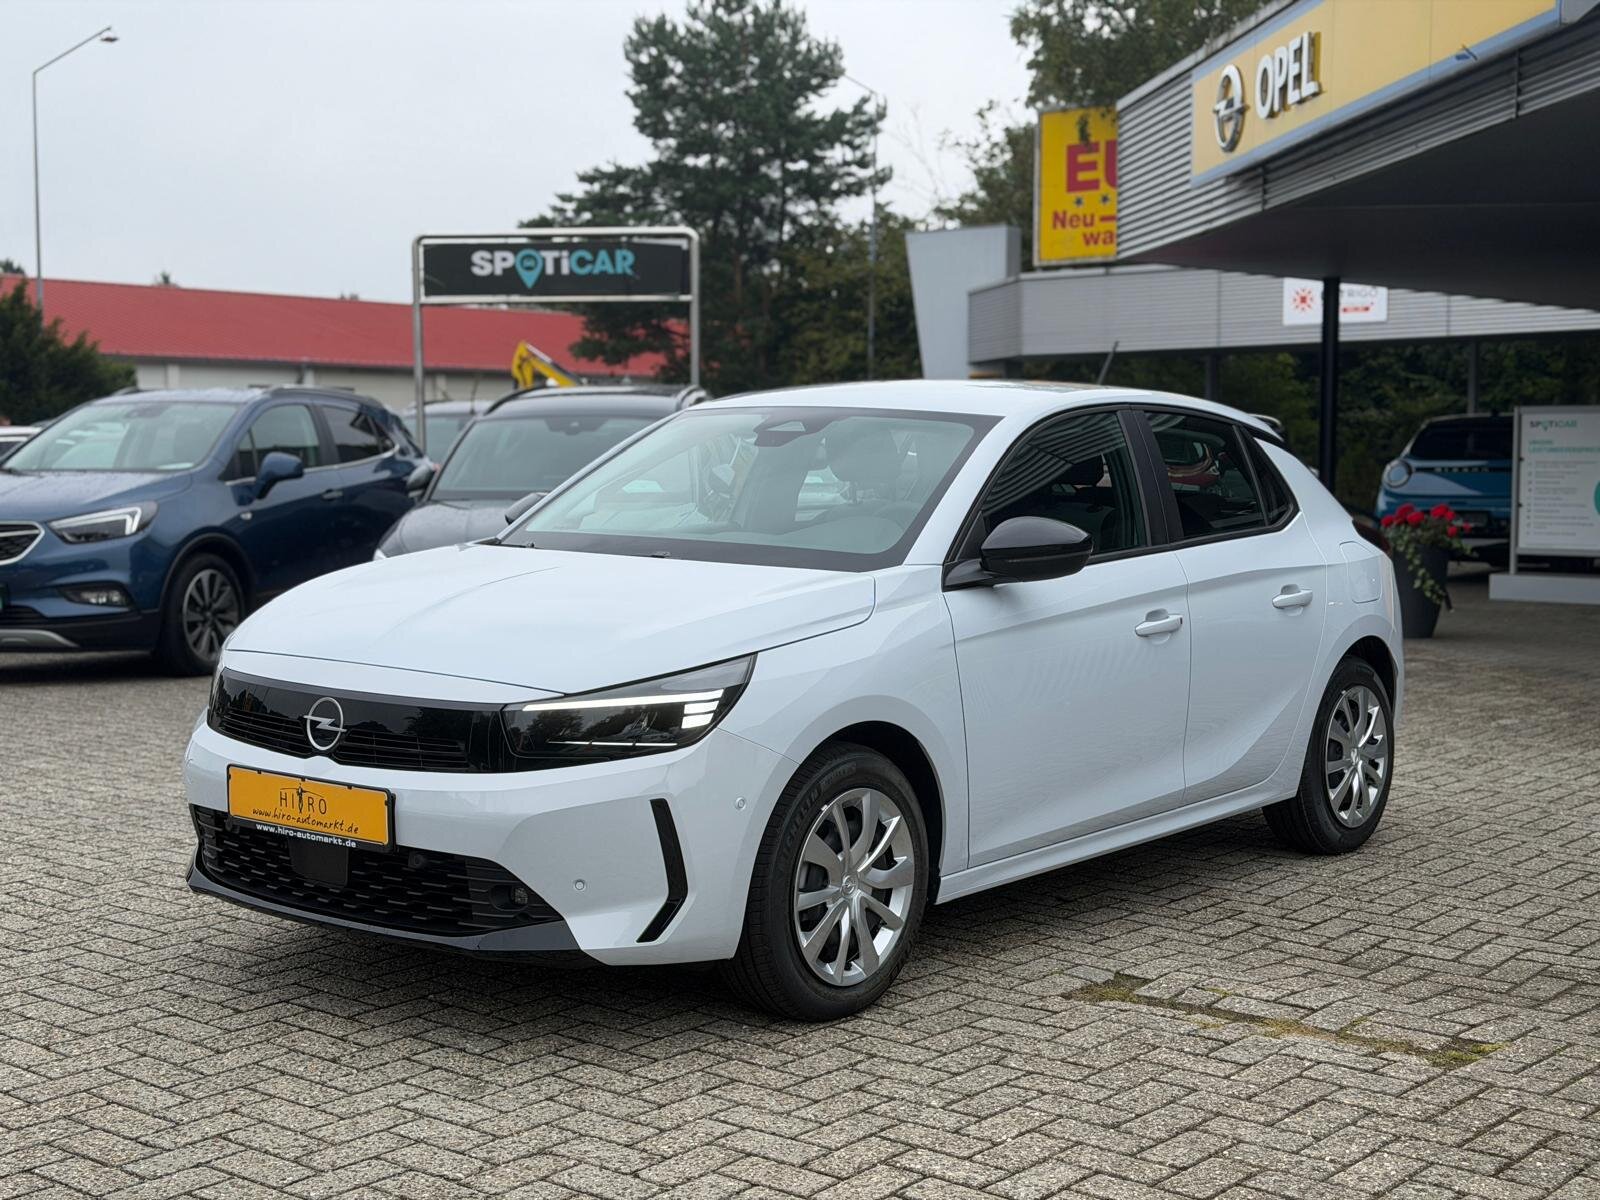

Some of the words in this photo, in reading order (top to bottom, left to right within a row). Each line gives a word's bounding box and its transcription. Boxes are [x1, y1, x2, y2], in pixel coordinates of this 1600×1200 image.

[1255, 31, 1319, 119] OPEL
[279, 790, 327, 815] HIRO
[252, 807, 359, 834] www.hiro-automarkt.de
[255, 823, 357, 848] www.hiro-automarkt.de
